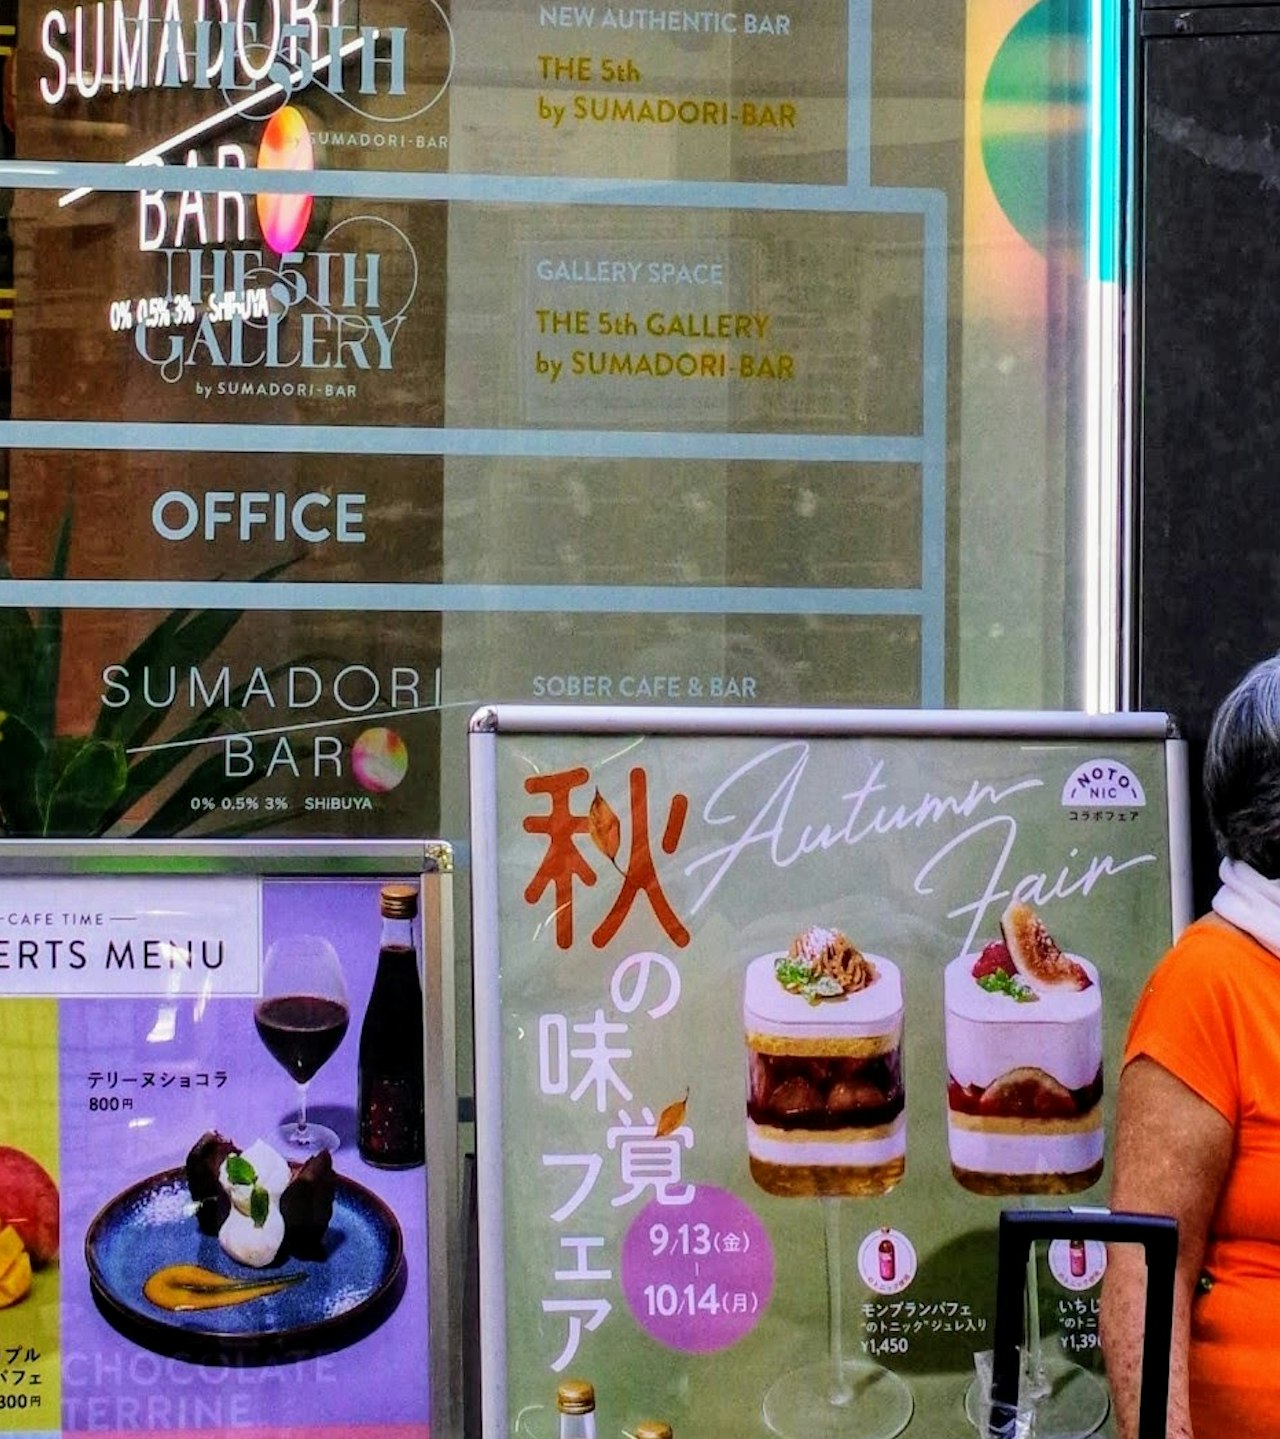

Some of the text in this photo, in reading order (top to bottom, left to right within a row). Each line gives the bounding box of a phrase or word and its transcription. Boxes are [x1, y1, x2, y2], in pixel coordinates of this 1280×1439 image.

[540, 7, 791, 35] NEW AUTHENTIC BAR
[538, 56, 641, 83] THE 5th
[538, 97, 797, 129] by SUMADORI-BAR
[137, 144, 247, 252] BAR
[537, 261, 723, 285] GALLERY SPACE
[536, 311, 771, 340] THE 5th GALLERY
[135, 313, 406, 383] GALLERY
[536, 351, 794, 382] by SUMADORI-BAR
[196, 382, 357, 399] by SUMADORI-BAR
[151, 491, 366, 543] OFFICE
[100, 664, 442, 709] SUMADORI
[533, 675, 757, 699] SOBER CAFE & BAR
[223, 735, 343, 778] BAR
[1078, 767, 1129, 788] NOTO
[190, 796, 373, 811] 0% 0.5% 3% SHIBUYA
[1090, 788, 1116, 798] NIC
[685, 741, 1043, 918] Autumn
[914, 816, 1157, 958] Fair
[7, 913, 105, 926] CAFE TIME
[104, 940, 227, 972] MENU
[87, 1069, 229, 1090] テリーヌショコラ
[88, 1095, 134, 1113] 800円
